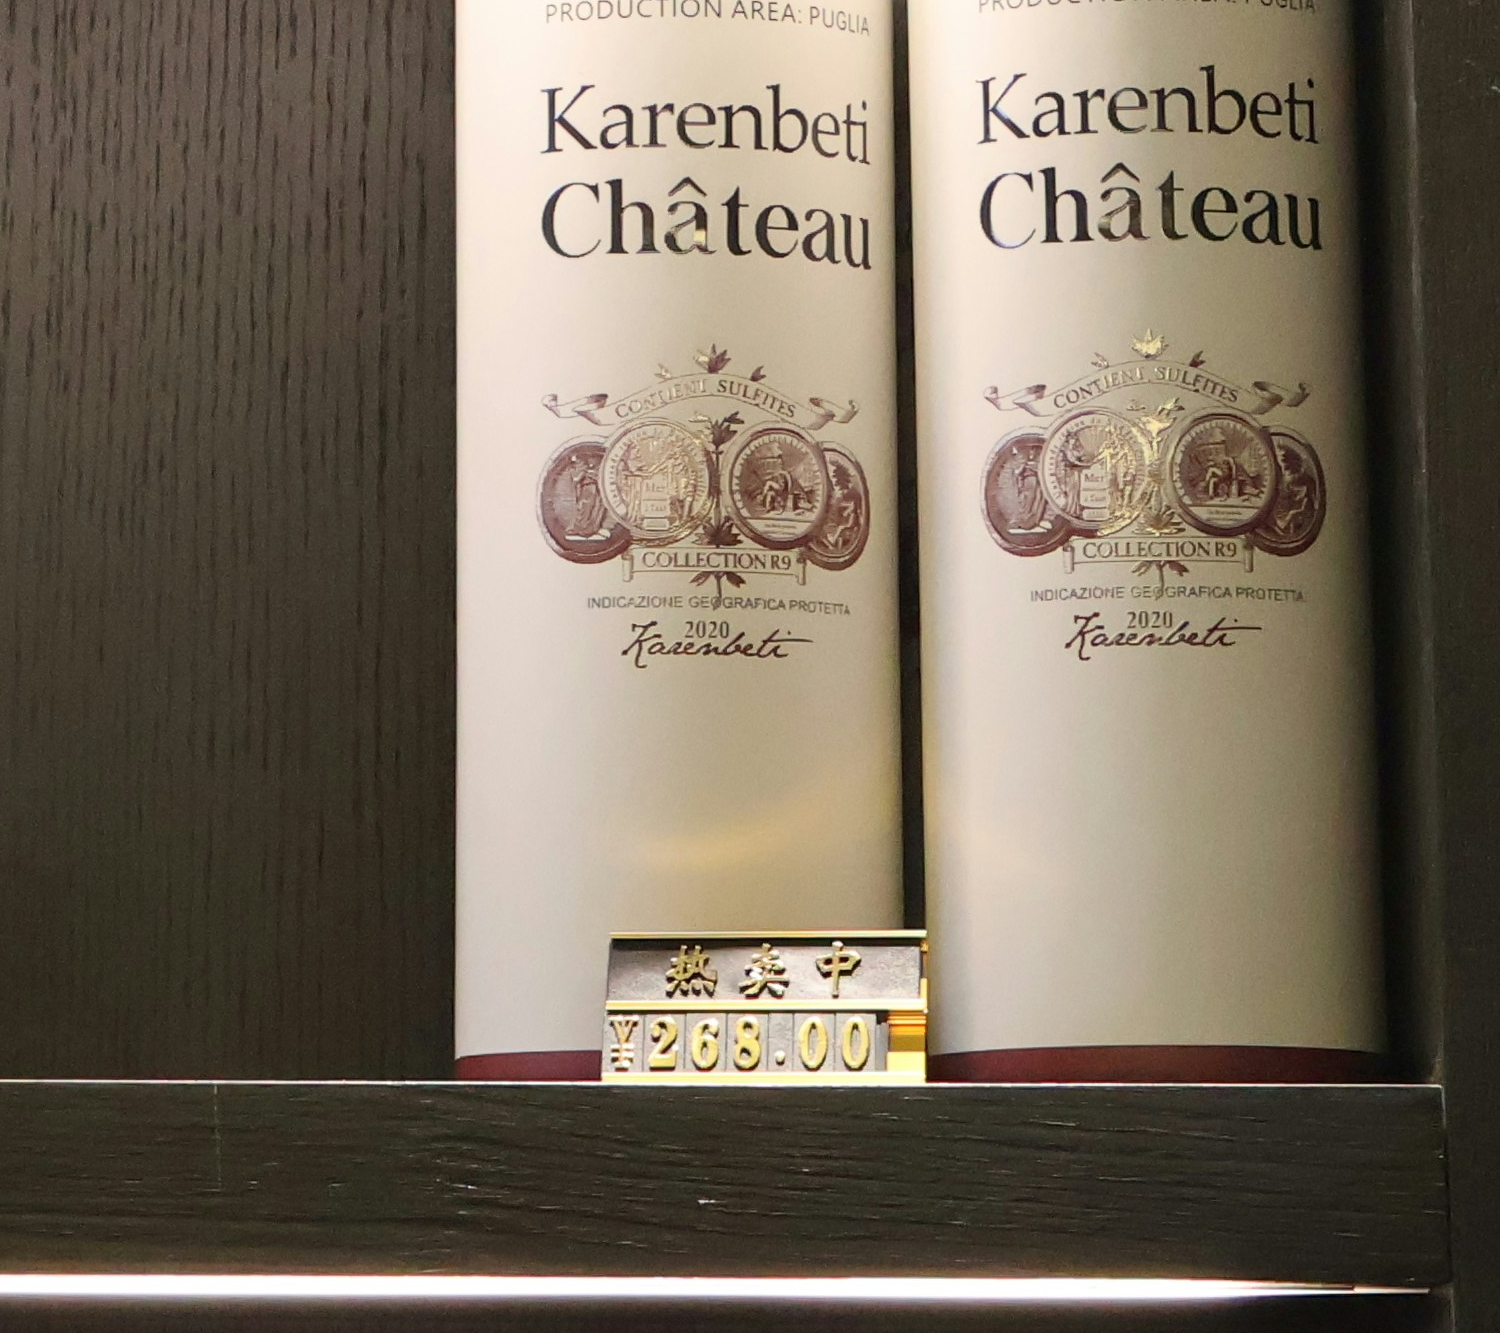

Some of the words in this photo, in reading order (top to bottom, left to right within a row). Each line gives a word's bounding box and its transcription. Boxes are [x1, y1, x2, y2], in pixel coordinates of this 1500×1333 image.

[731, 0, 802, 24] AREA:
[809, 6, 870, 36] PUGLIA
[540, 84, 870, 164] Karenbeti
[976, 65, 1319, 144] Karenbeti
[542, 177, 871, 270] Château
[980, 163, 1322, 249] Château
[615, 379, 710, 420] CONTIENT
[718, 379, 796, 418] SULFITES
[1053, 367, 1146, 409] CONTIENT
[1155, 367, 1239, 403] SULFITES
[642, 553, 766, 570] COLLECTION
[770, 555, 791, 570] R9
[1083, 542, 1209, 559] COLLECTION
[1214, 543, 1237, 559] R9
[587, 596, 683, 609] INDICAZIONE
[688, 596, 785, 611] GEOGRAFICA
[790, 600, 850, 615] PROTETTA
[1030, 587, 1125, 602] INDICAZIONE
[1130, 586, 1231, 600] GEOGRAFICA
[1235, 587, 1304, 602] PROTETTA
[684, 620, 729, 639] 2020
[1065, 611, 1261, 660] Karenbeti
[1127, 611, 1173, 629] 2020
[621, 620, 812, 669] Karenbeti
[665, 941, 861, 997] 热卖中
[609, 1015, 870, 1070] ¥268.00
